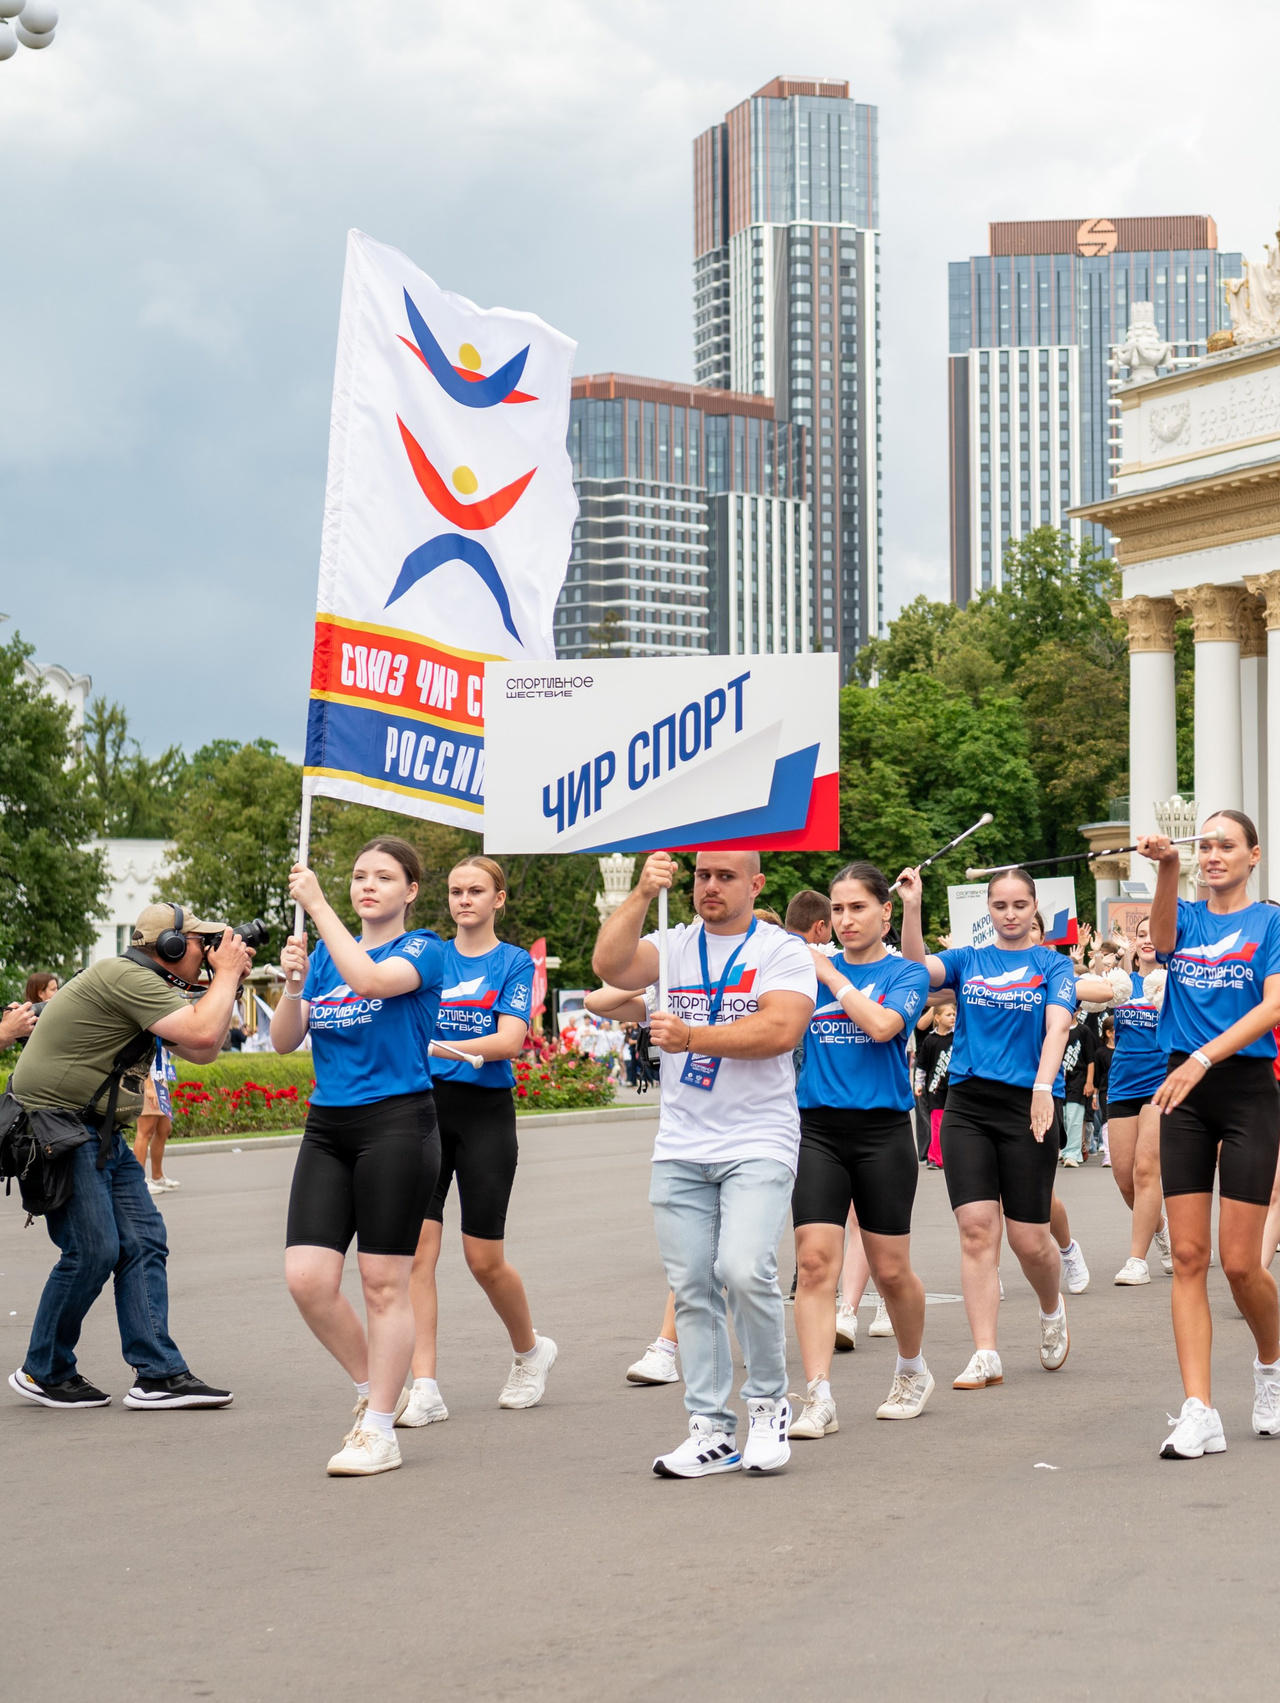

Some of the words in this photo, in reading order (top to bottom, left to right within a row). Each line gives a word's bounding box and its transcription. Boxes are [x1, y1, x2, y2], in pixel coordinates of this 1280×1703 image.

[341, 642, 409, 696] СОЮЗ
[415, 659, 459, 711] ЧИР
[506, 690, 573, 698] ШЕСТВИЕ
[542, 750, 616, 834] ЧИР
[627, 670, 751, 791] СПОРТ
[1176, 974, 1244, 990] ШЕСТВИЕ
[310, 999, 383, 1019] ПОРТИВНОЕ
[966, 997, 1033, 1011] ШЕСТВИЕ
[1115, 1009, 1160, 1021] СПОРТИВН
[1119, 1019, 1159, 1027] ШЕСТВИ
[819, 1035, 881, 1044] ШЕСТВИ
